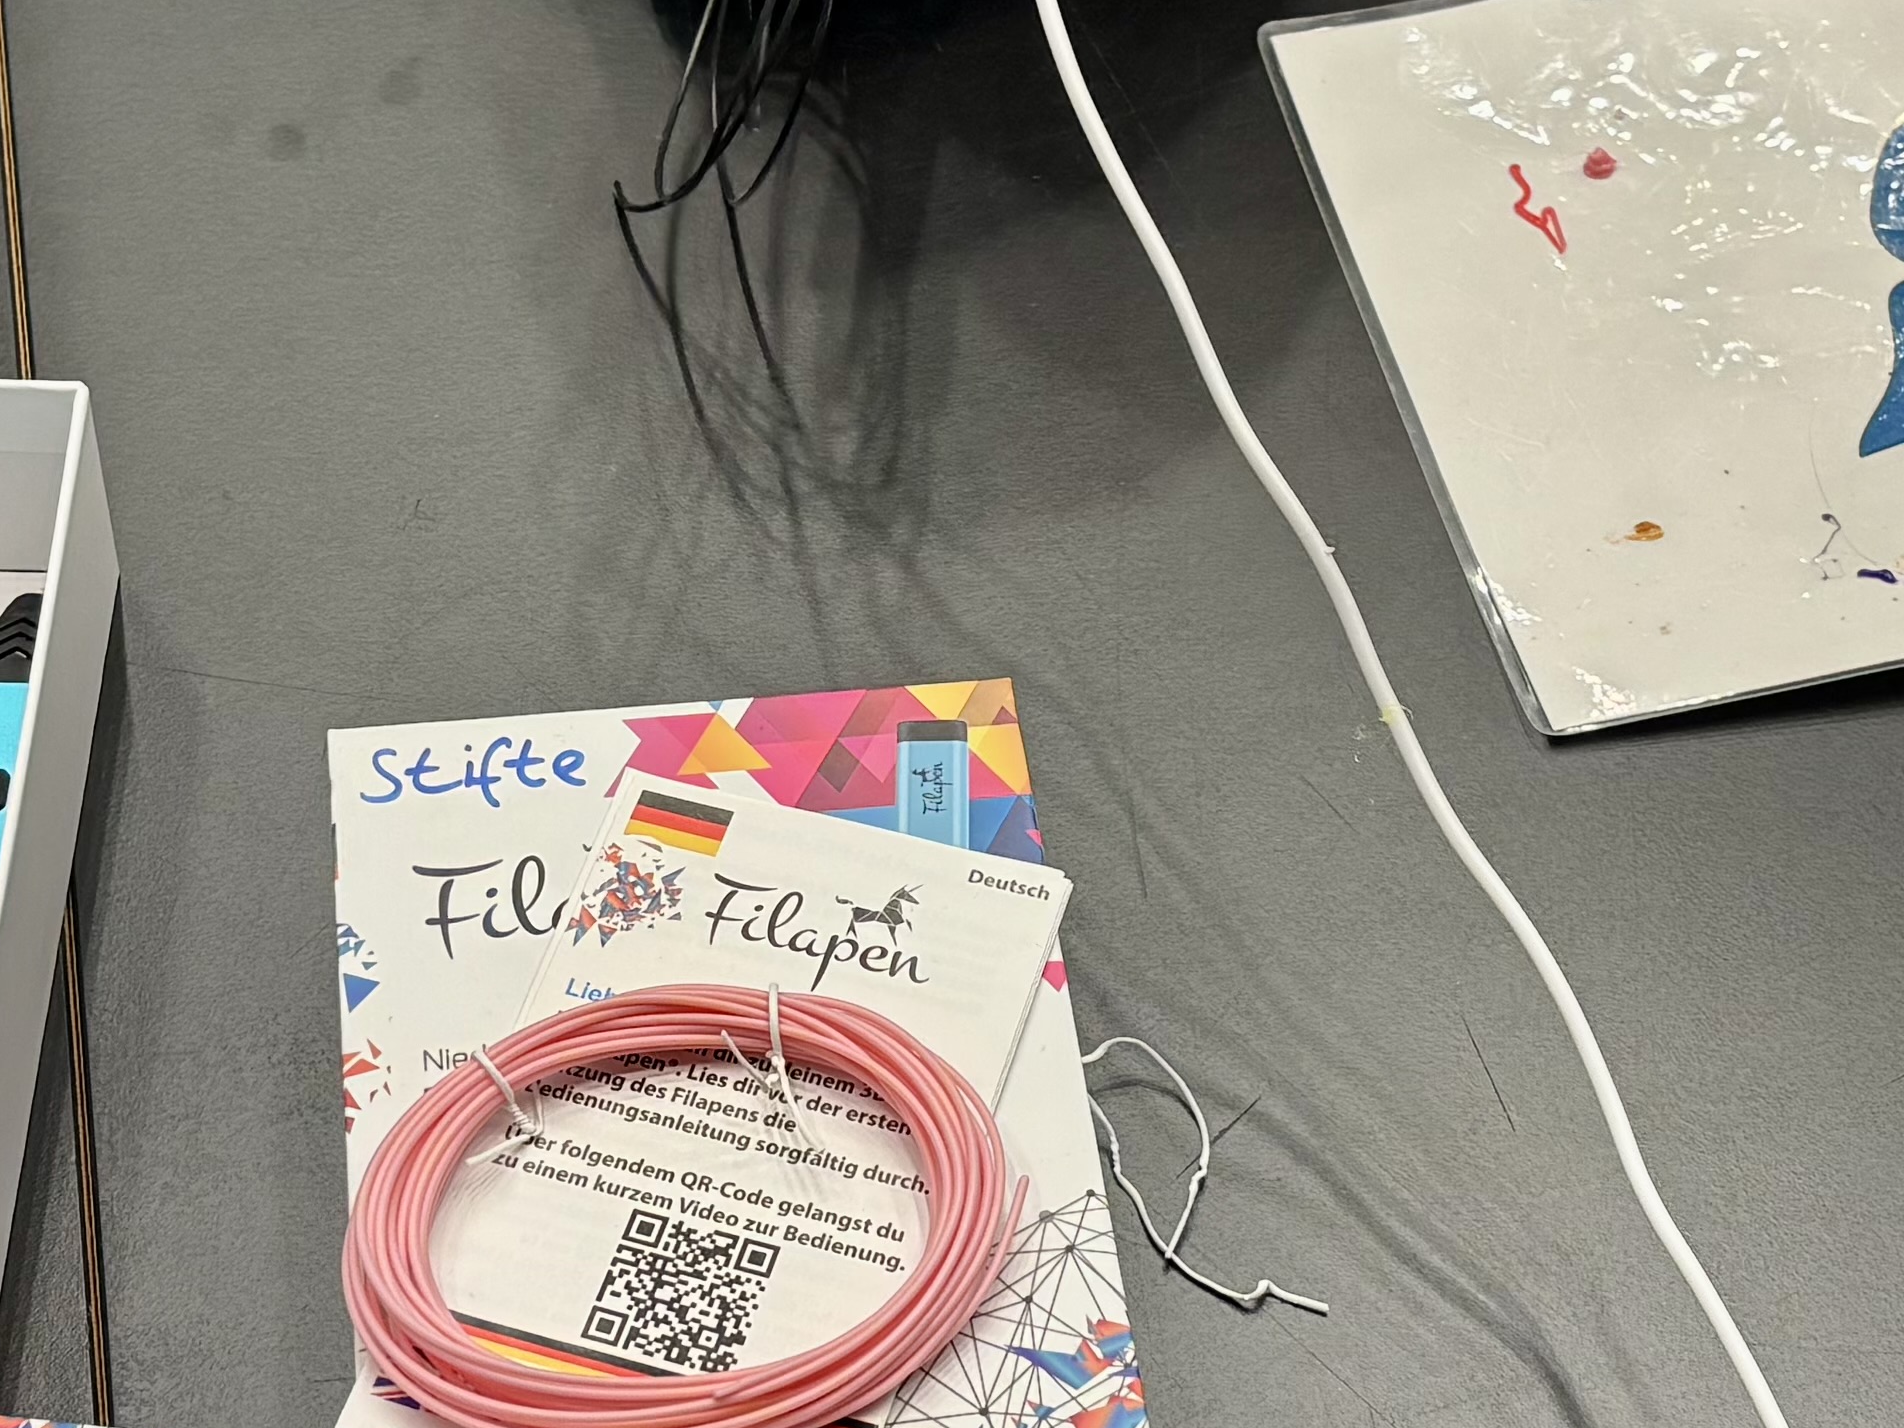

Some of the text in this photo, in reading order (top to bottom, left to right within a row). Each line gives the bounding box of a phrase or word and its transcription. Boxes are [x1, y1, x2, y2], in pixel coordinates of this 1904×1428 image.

[358, 737, 588, 810] Stifte
[967, 868, 1051, 901] Deutsch
[706, 869, 931, 992] Filapen
[629, 1076, 669, 1100] des
[670, 1086, 761, 1126] Filapens
[763, 1111, 798, 1134] die
[687, 1062, 730, 1089] Lies
[805, 1095, 844, 1118] der
[845, 1107, 913, 1137] ersten
[560, 1139, 906, 1244] folgendem QR-Code gelangst du
[754, 1136, 932, 1197] sorgfältig durch.
[522, 1158, 590, 1189] einem
[593, 1174, 674, 1211] kurzem
[679, 1196, 740, 1228] Video
[743, 1218, 780, 1238] zur
[782, 1224, 907, 1275] Bedienung.
